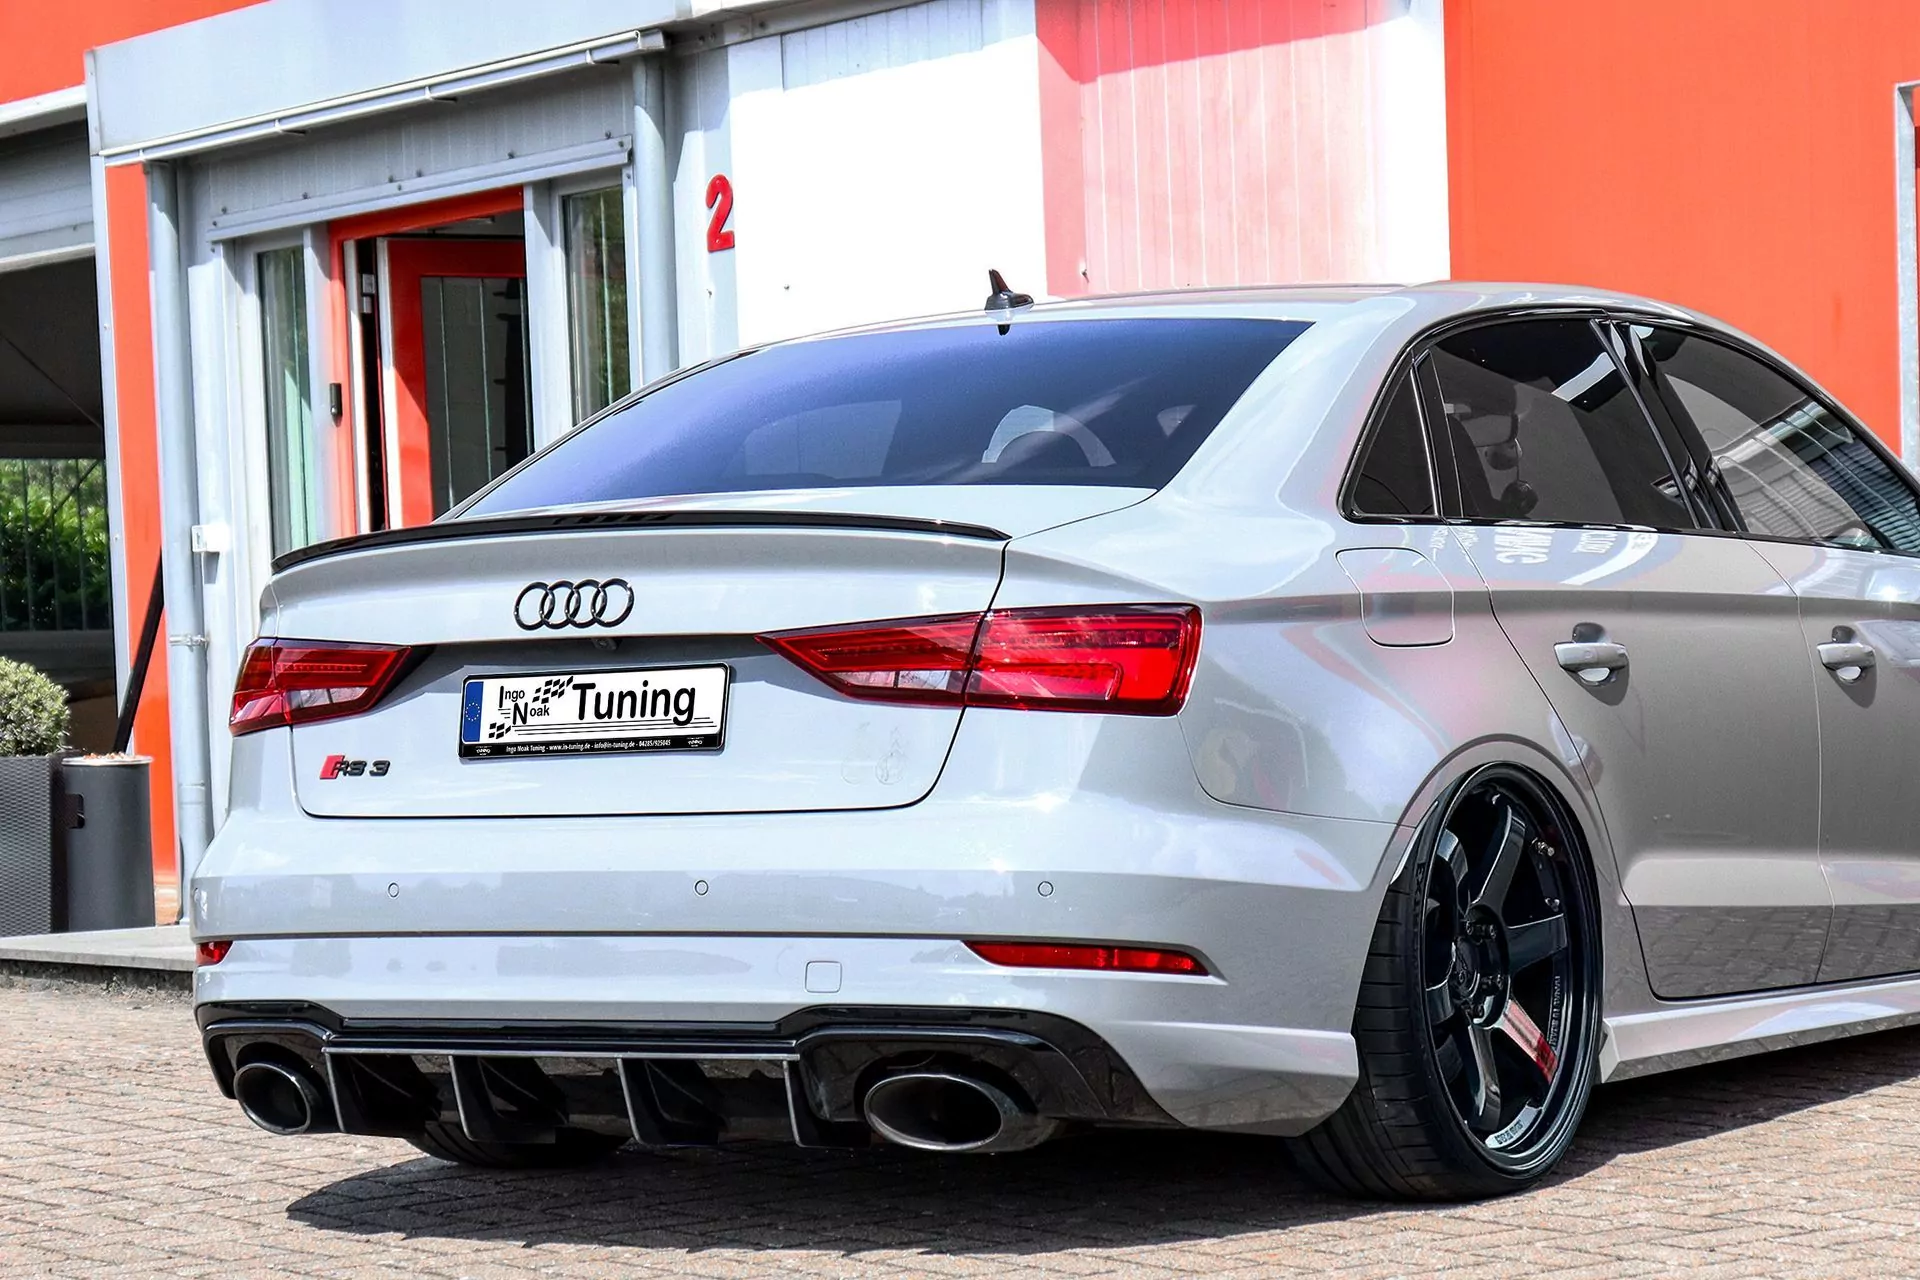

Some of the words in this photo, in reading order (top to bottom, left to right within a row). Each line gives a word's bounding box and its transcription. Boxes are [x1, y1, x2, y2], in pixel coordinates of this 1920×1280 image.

[706, 174, 735, 253] 2
[498, 686, 526, 708] Ingo
[572, 680, 696, 726] Tuning
[512, 702, 550, 725] Noak
[324, 756, 367, 778] RS
[369, 760, 391, 776] 3
